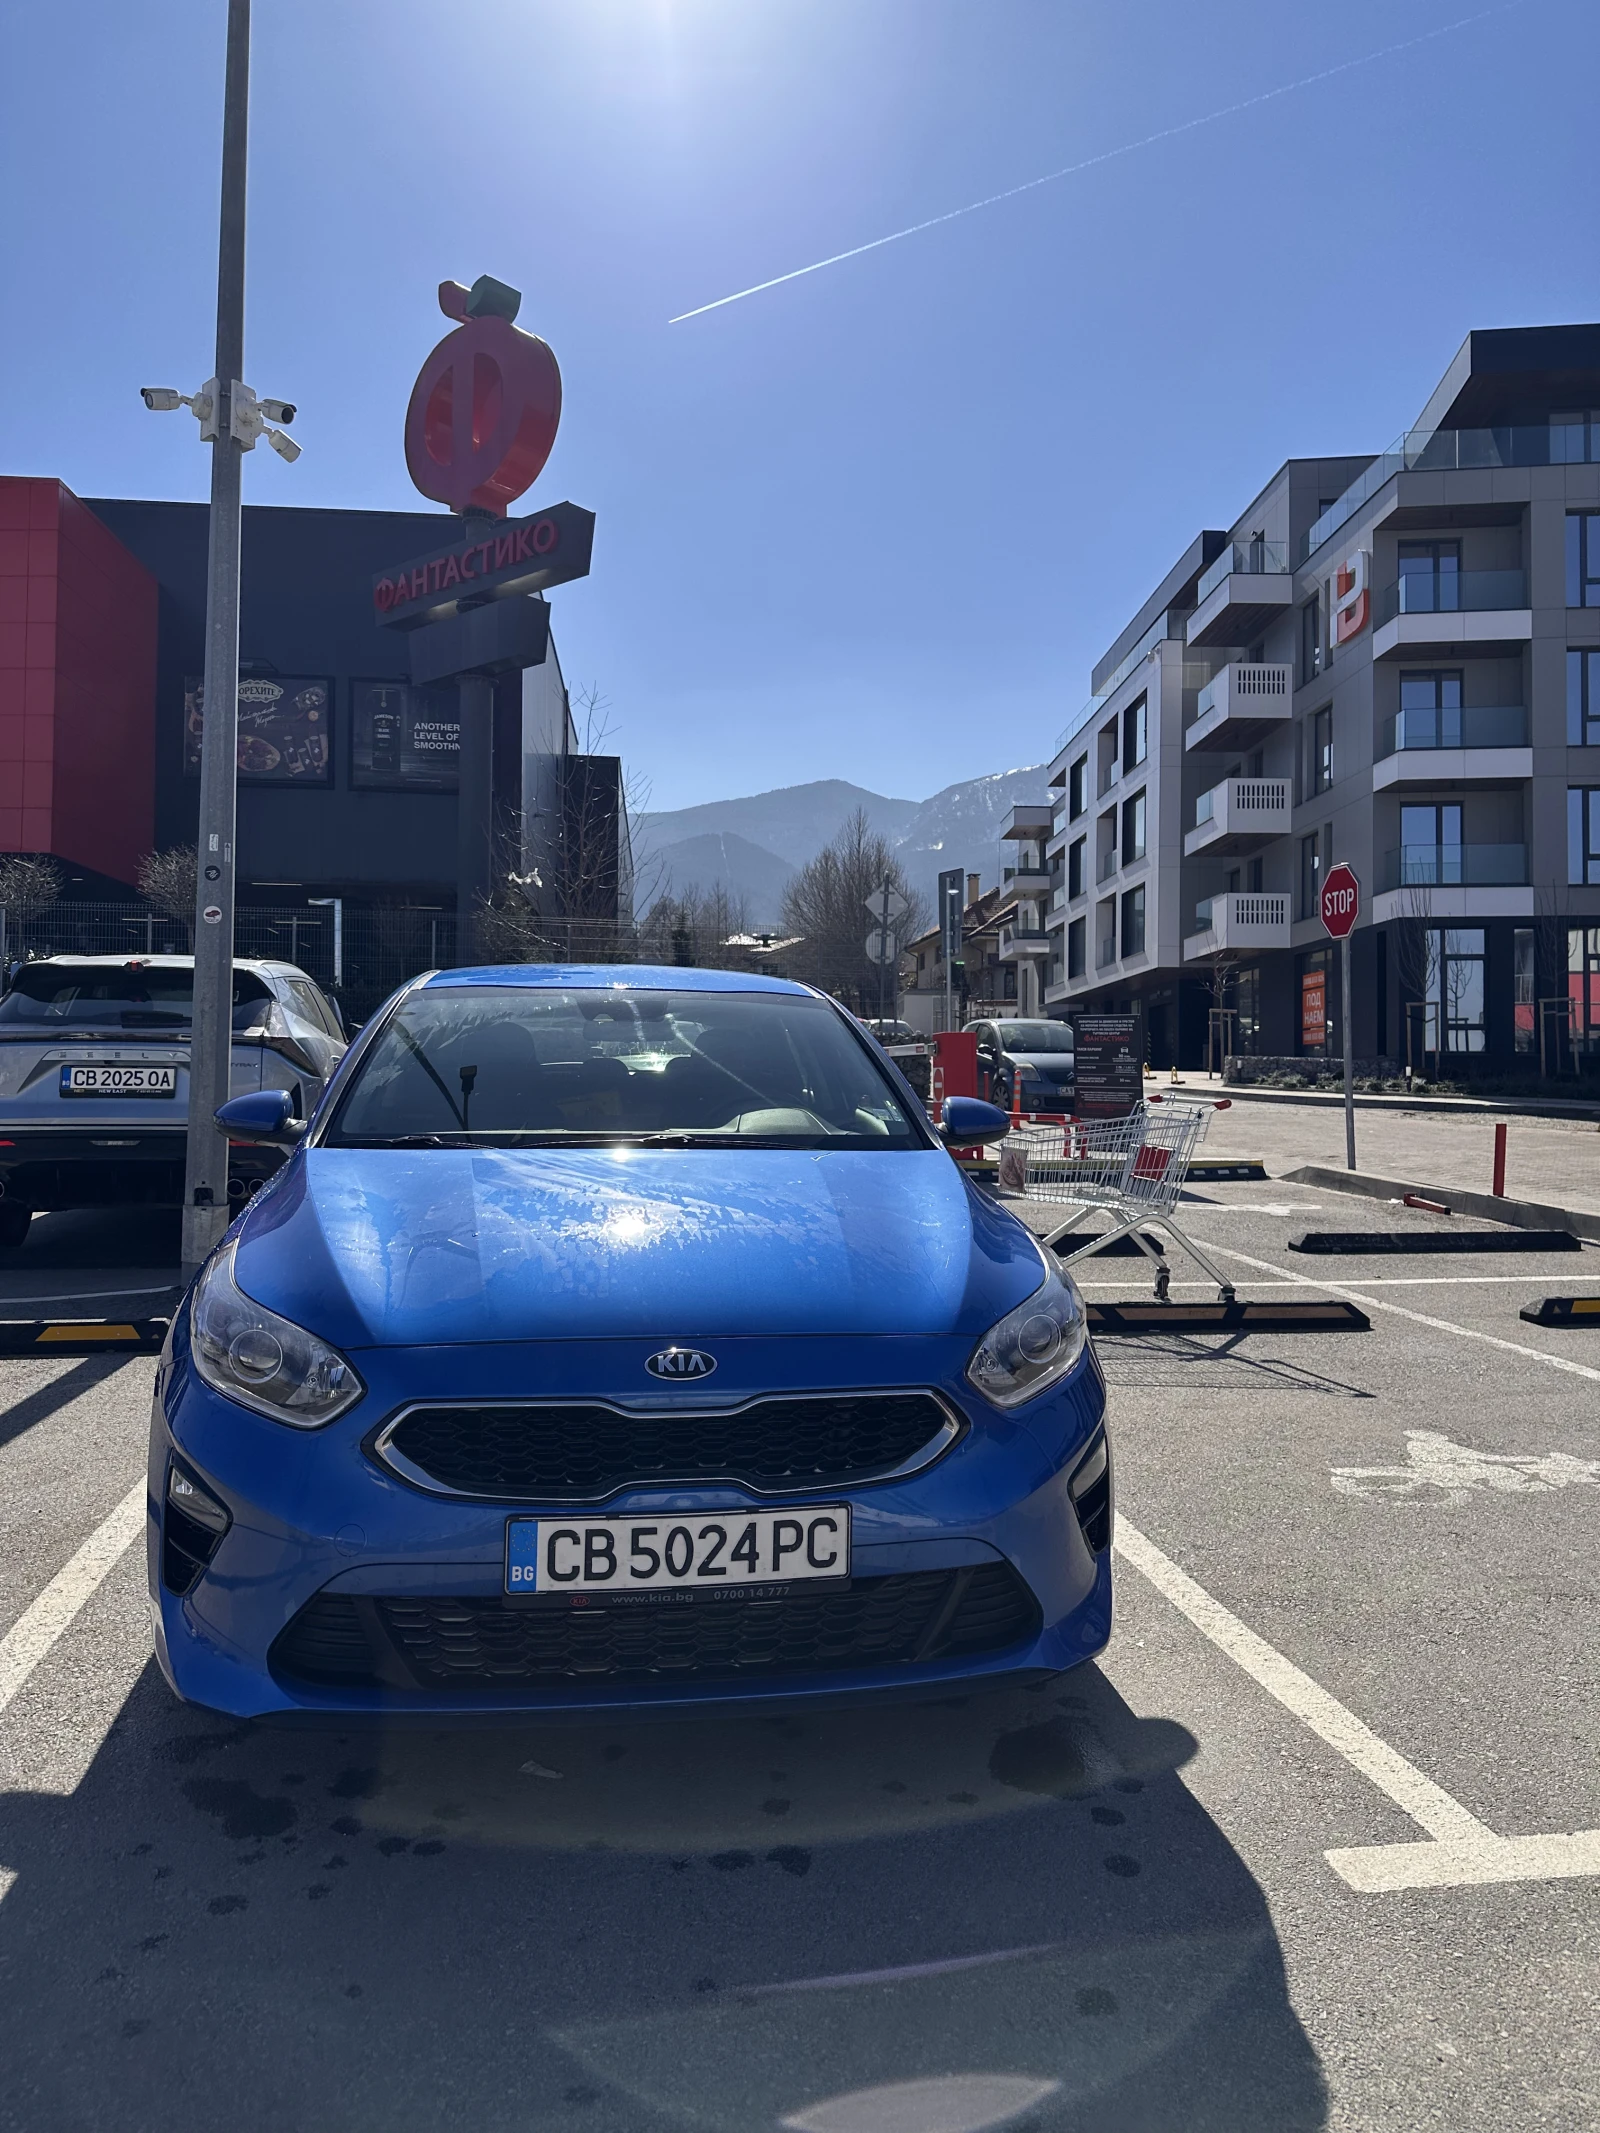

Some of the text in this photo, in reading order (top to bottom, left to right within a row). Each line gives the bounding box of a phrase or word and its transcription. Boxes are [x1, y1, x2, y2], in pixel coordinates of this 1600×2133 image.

[374, 518, 559, 613] ФАНТАСТИКО
[238, 686, 276, 696] ОРЕХИТЕ
[414, 722, 460, 732] ANOTHER
[414, 732, 460, 741] LEVEL OF
[413, 741, 460, 750] SMOOTHN
[1325, 887, 1355, 917] STOP
[1306, 992, 1322, 1008] ПОД
[1304, 1009, 1324, 1025] НАЕМ
[1083, 1034, 1130, 1043] ФАНТАСТИКО
[74, 1069, 97, 1087] CB
[101, 1070, 144, 1087] 2025
[148, 1070, 171, 1087] OA
[657, 1353, 706, 1373] KIA
[511, 1516, 838, 1583] BG CB 5024 PC
[611, 1593, 694, 1605] www.kia.bg
[713, 1588, 745, 1600] 0700
[749, 1587, 765, 1599] 14
[767, 1586, 790, 1598] 777
